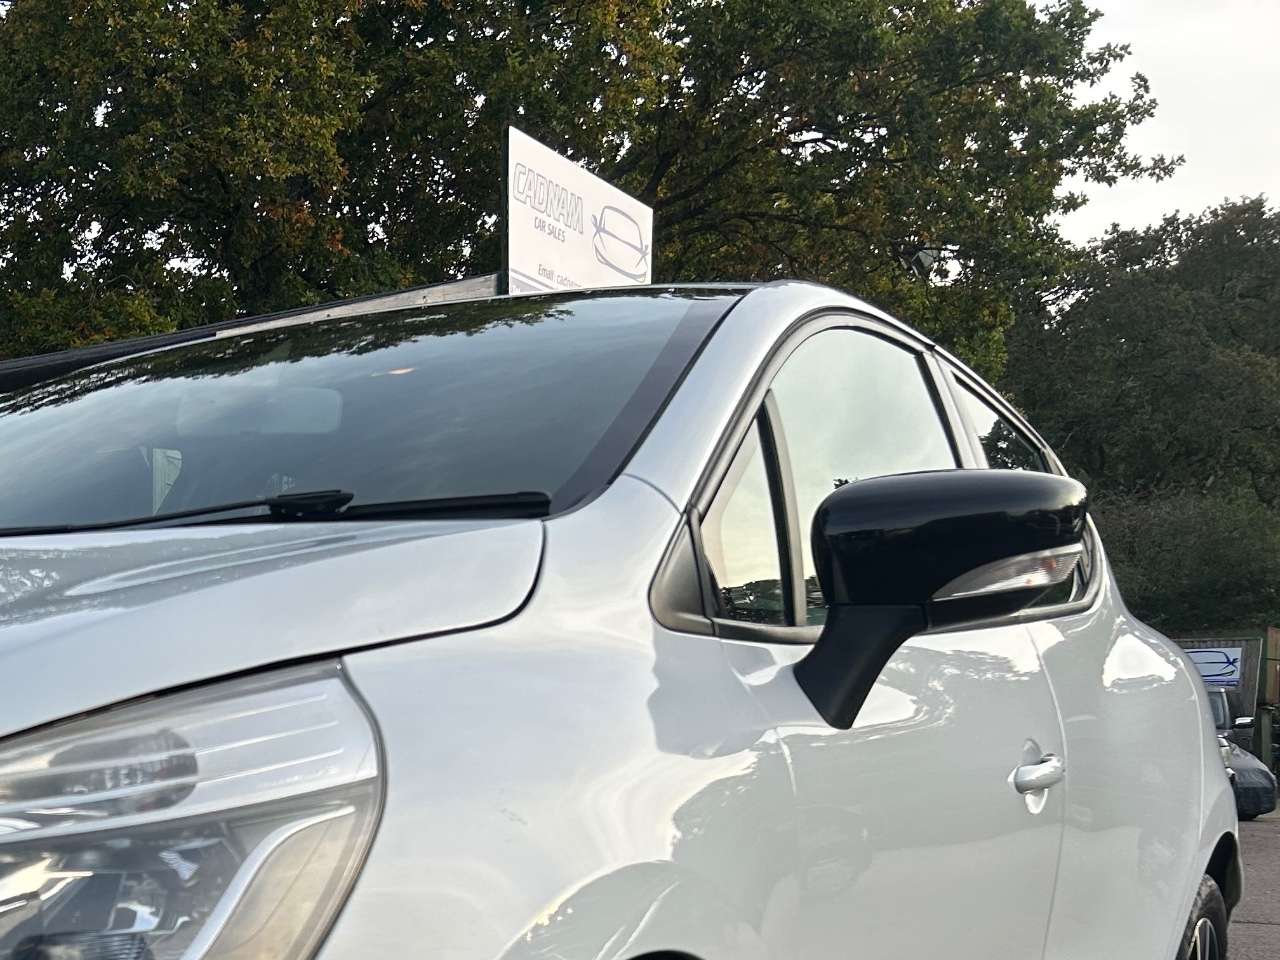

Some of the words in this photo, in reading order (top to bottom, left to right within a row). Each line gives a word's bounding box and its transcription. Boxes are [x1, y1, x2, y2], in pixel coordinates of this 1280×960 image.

[512, 162, 584, 235] CADNAM
[534, 216, 546, 233] CAR
[547, 223, 566, 243] SALES
